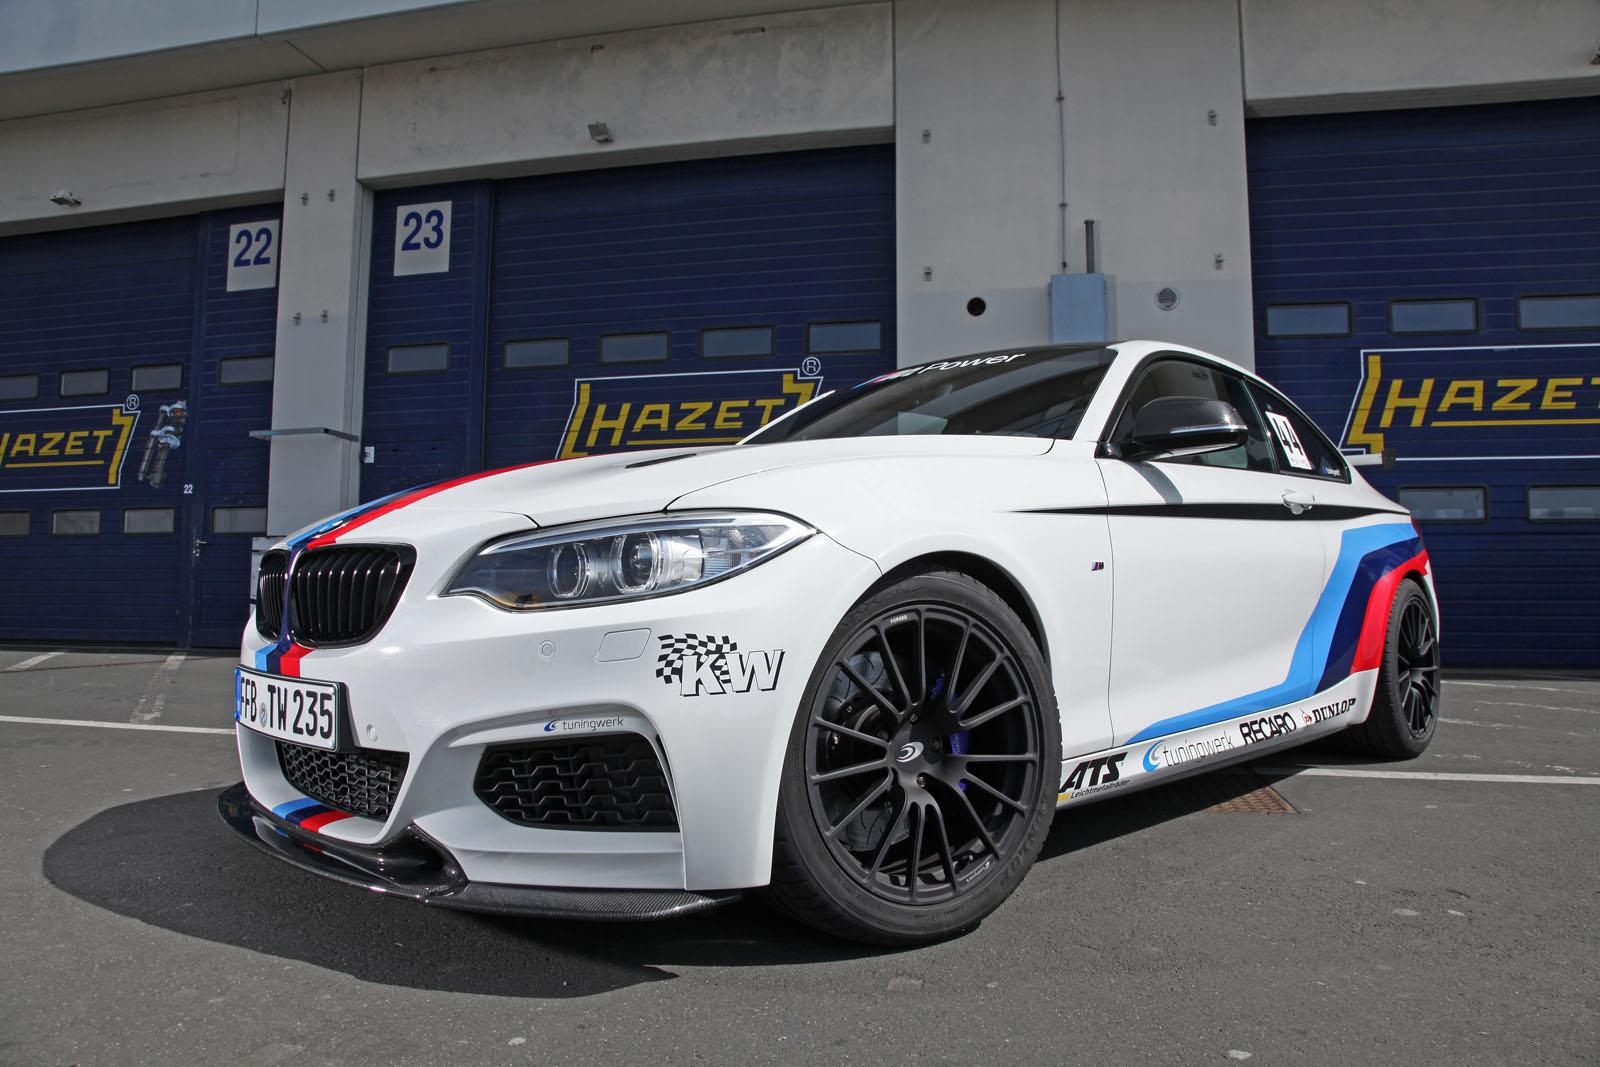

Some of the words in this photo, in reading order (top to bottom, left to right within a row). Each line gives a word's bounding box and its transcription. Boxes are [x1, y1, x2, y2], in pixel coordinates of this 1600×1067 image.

[233, 227, 272, 267] 22
[401, 209, 444, 251] 23
[917, 353, 1026, 375] Power
[586, 398, 785, 447] HAZET
[1271, 417, 1304, 456] 44
[183, 483, 193, 494] 22
[679, 648, 786, 697] KW
[267, 683, 288, 731] TW
[292, 689, 333, 739] 235
[562, 715, 624, 732] tuningwerk
[1239, 711, 1297, 746] RECARO
[1311, 697, 1356, 724] DUNLOP
[1162, 730, 1234, 766] tuningwerk
[1058, 751, 1128, 793] ATS
